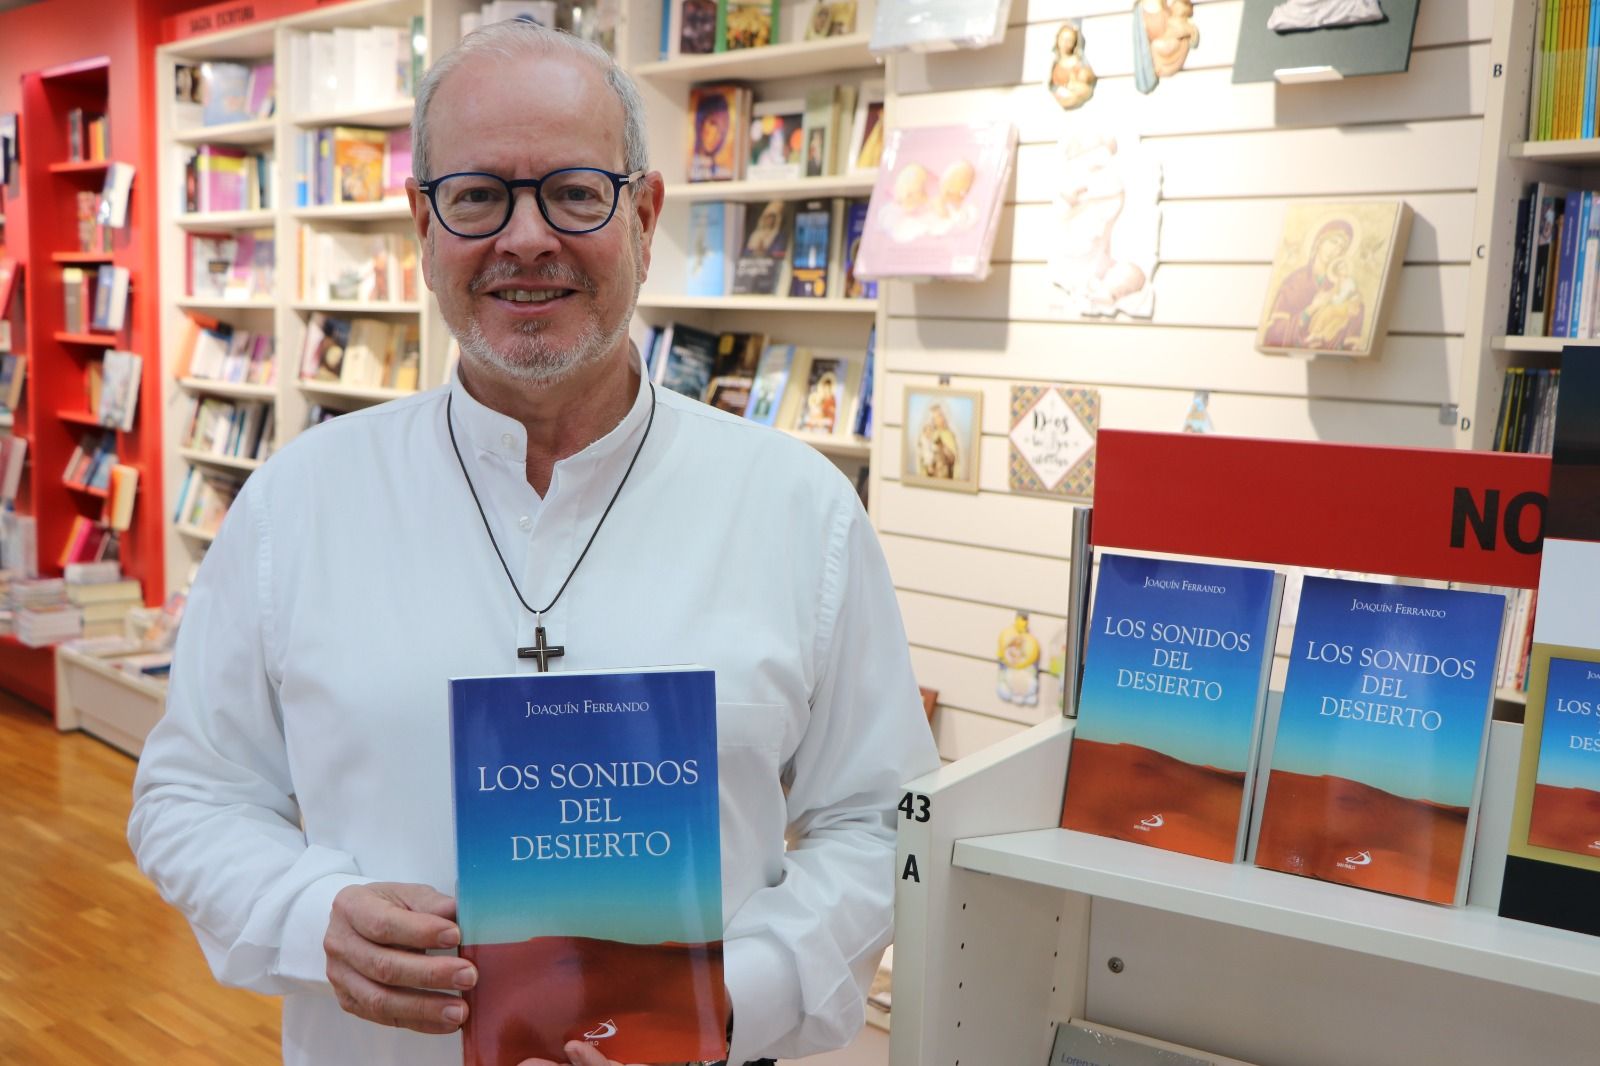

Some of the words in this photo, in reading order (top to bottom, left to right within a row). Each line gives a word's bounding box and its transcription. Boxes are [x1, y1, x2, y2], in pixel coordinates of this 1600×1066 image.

[1493, 63, 1503, 78] B
[1477, 244, 1485, 259] C
[1461, 416, 1471, 431] D
[1450, 487, 1548, 555] NO
[1104, 616, 1146, 639] LOS
[1151, 622, 1251, 652] SONIDOS
[1152, 648, 1193, 671] DEL
[1306, 640, 1353, 665] LOS
[1359, 647, 1476, 680] SONIDOS
[1116, 668, 1223, 701] DESIERTO
[1360, 674, 1408, 699] DEL
[1319, 695, 1442, 731] DESIERTO
[1557, 698, 1591, 715] LOS
[477, 764, 540, 792] LOS
[550, 759, 699, 788] SONIDOS
[559, 798, 622, 824] DEL
[897, 792, 931, 823] 43
[511, 830, 671, 861] DESIERTO
[902, 854, 920, 883] A
